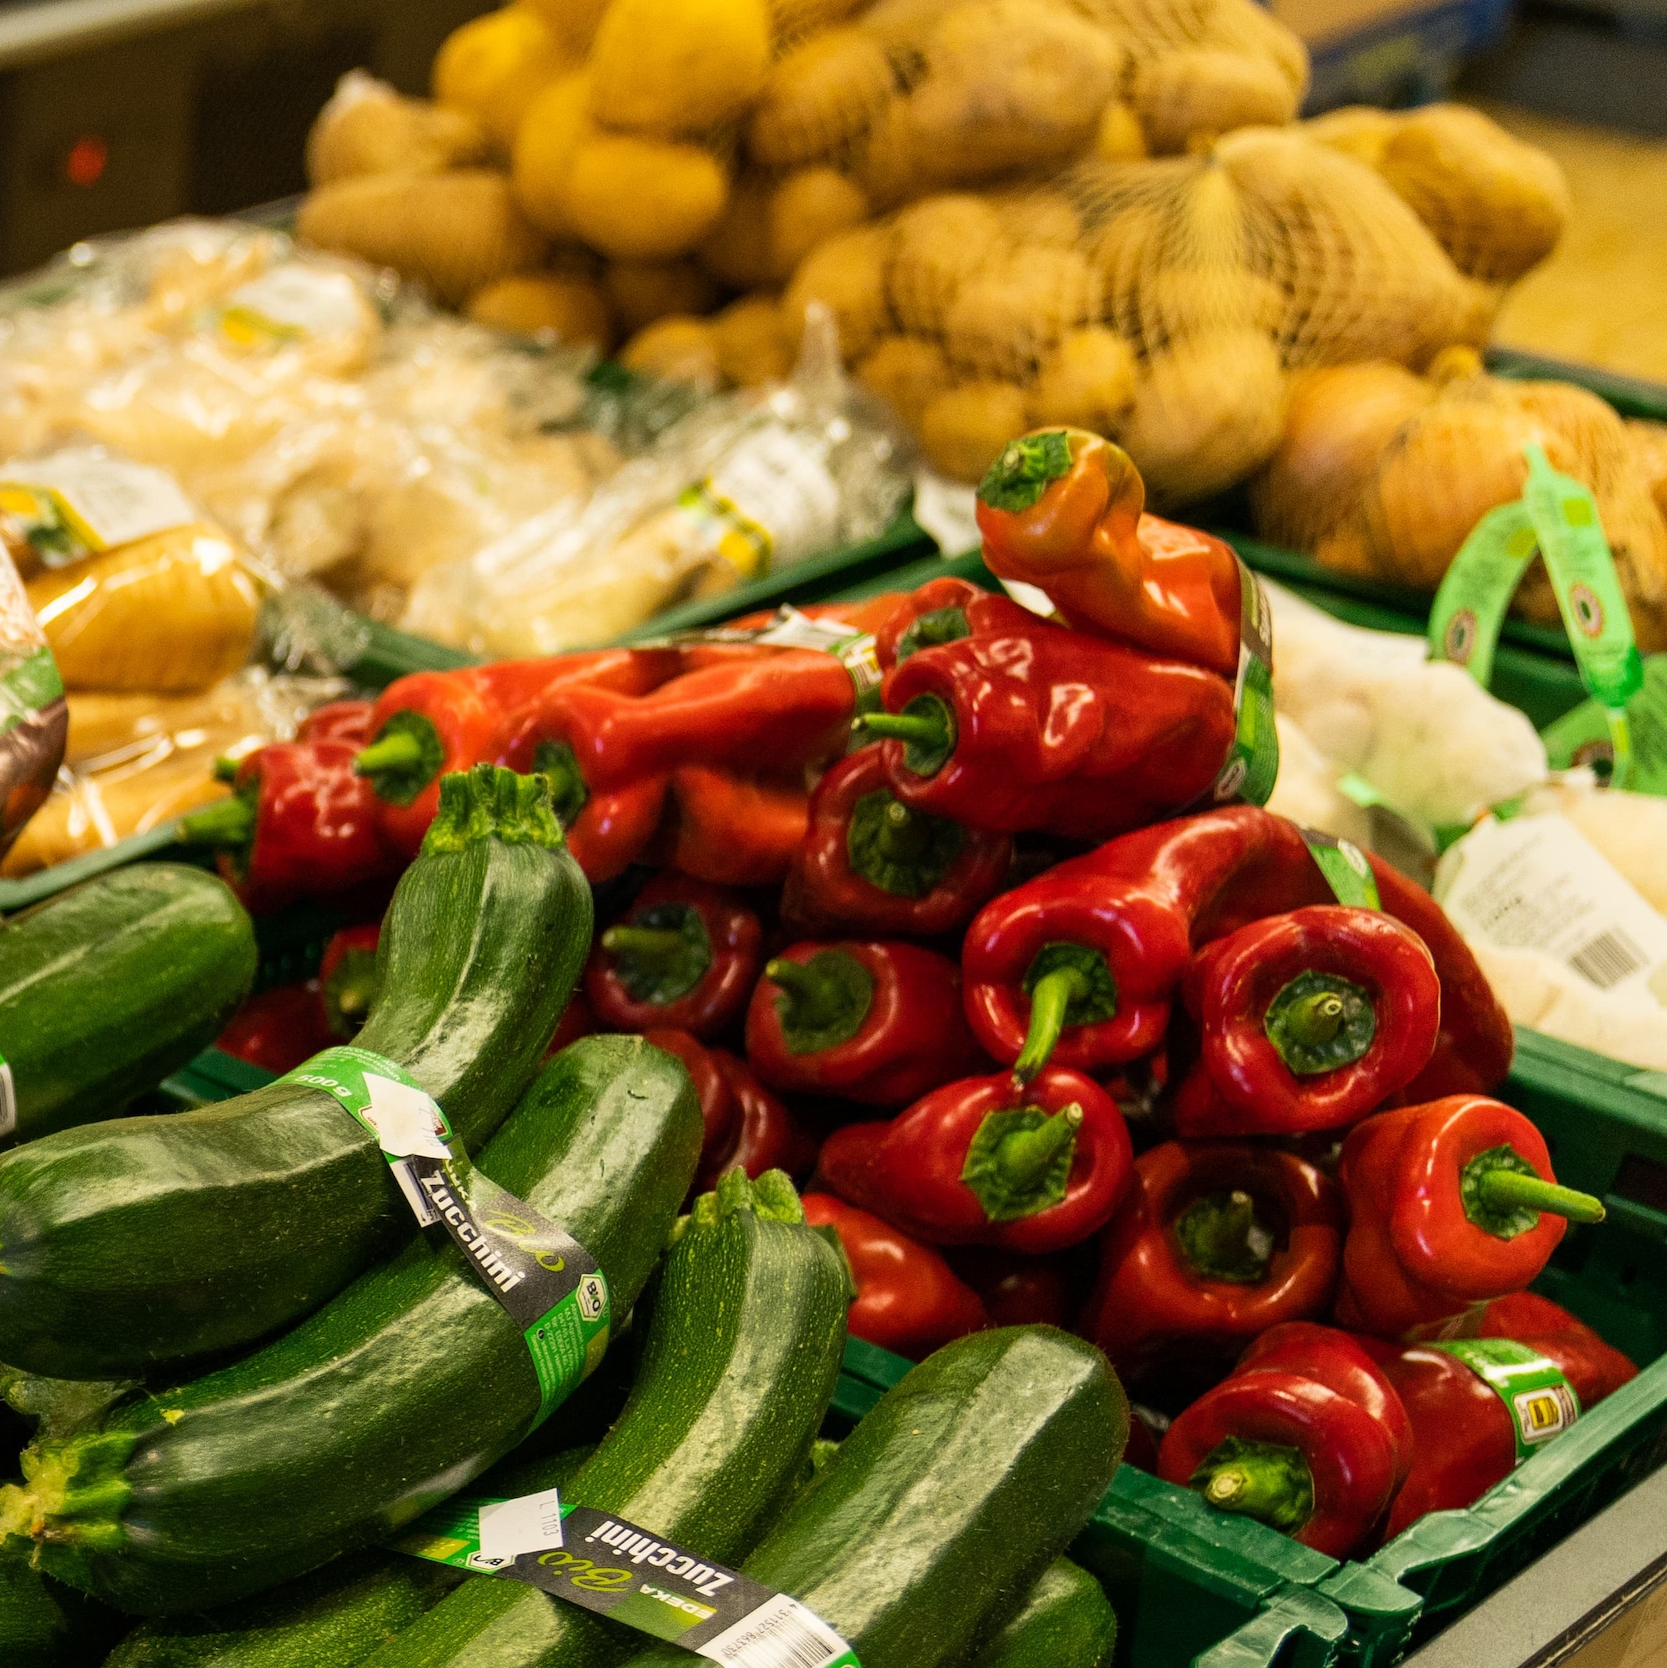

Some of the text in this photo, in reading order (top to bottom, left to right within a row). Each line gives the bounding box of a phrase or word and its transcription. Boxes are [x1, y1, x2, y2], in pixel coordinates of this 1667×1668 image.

[419, 1169, 525, 1294] Zucchini
[486, 1208, 566, 1273] Bio
[537, 1551, 719, 1619] EDEKA Bio
[584, 1519, 735, 1598] Zucchini
